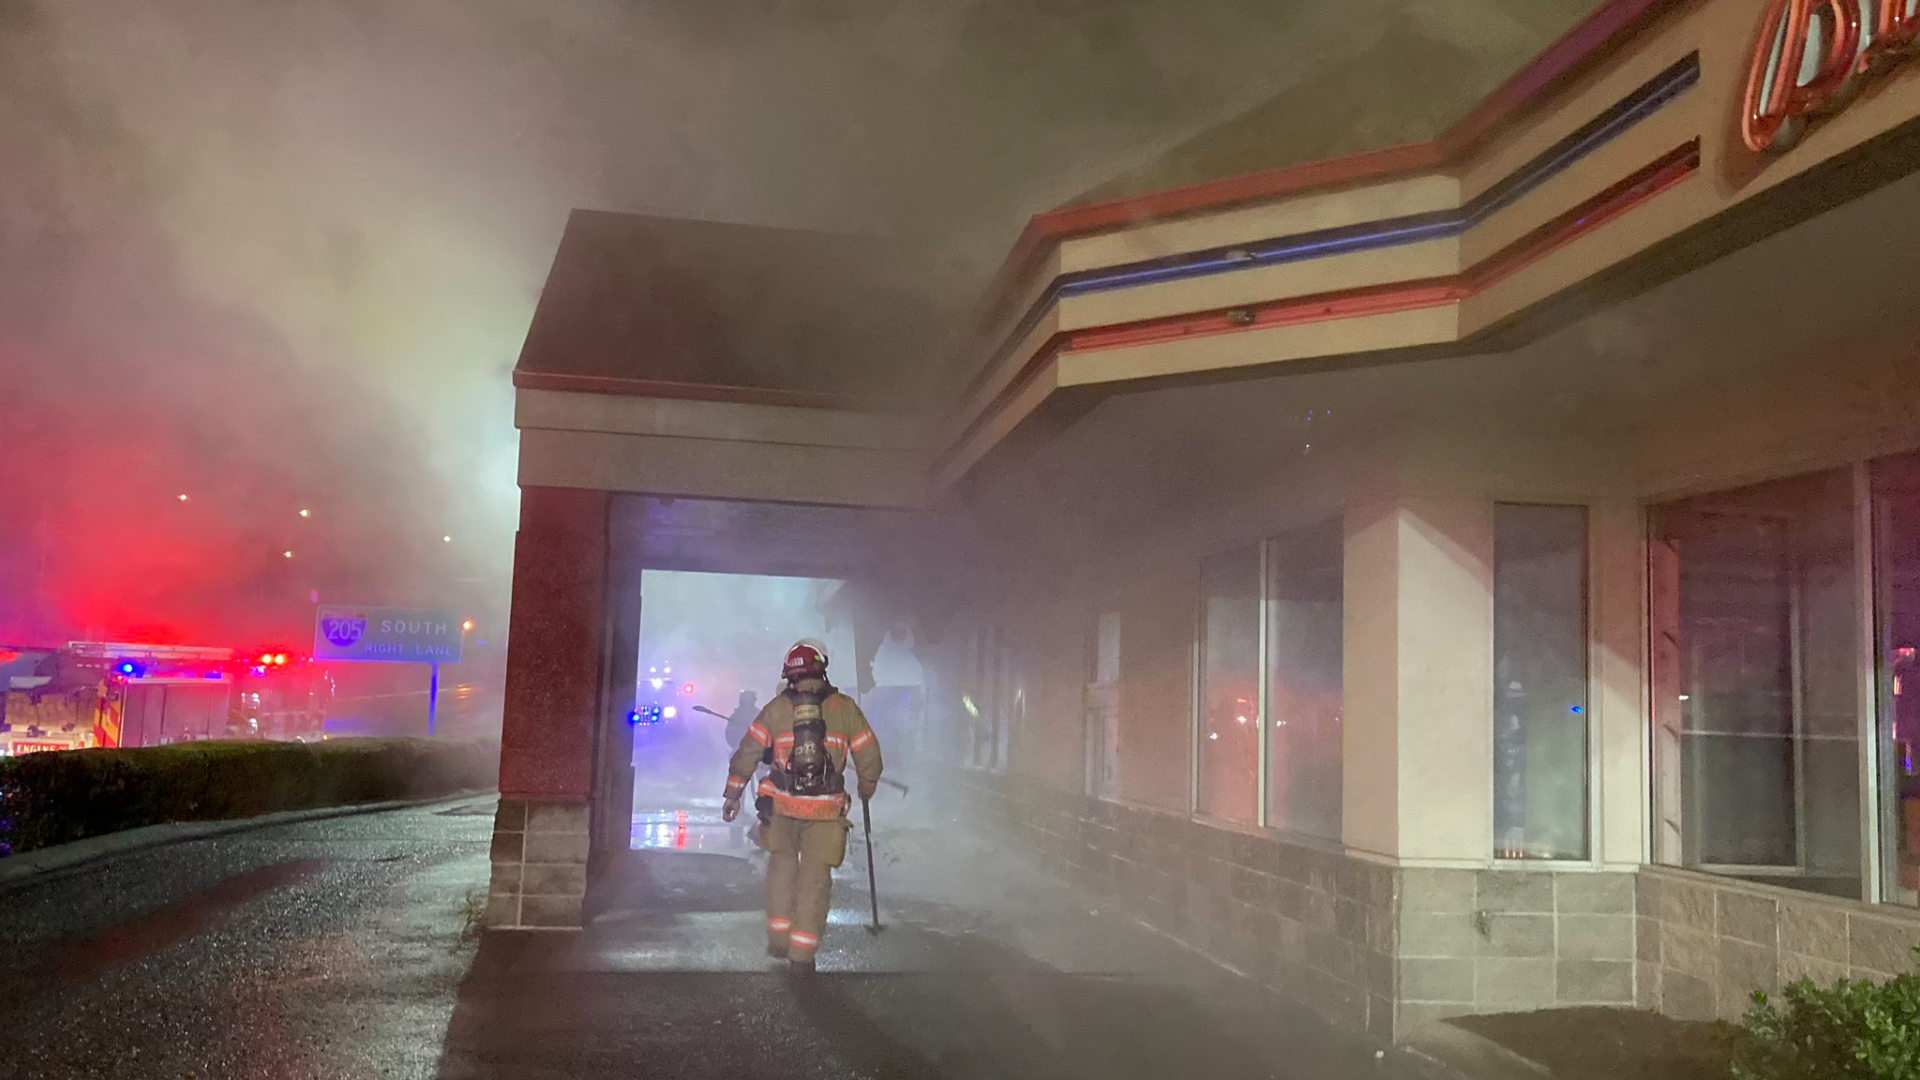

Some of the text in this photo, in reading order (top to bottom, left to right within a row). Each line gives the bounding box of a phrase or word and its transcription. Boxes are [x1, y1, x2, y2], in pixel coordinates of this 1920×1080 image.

[328, 619, 447, 640] 205 SOUTH
[364, 643, 453, 656] RIGHT LANE
